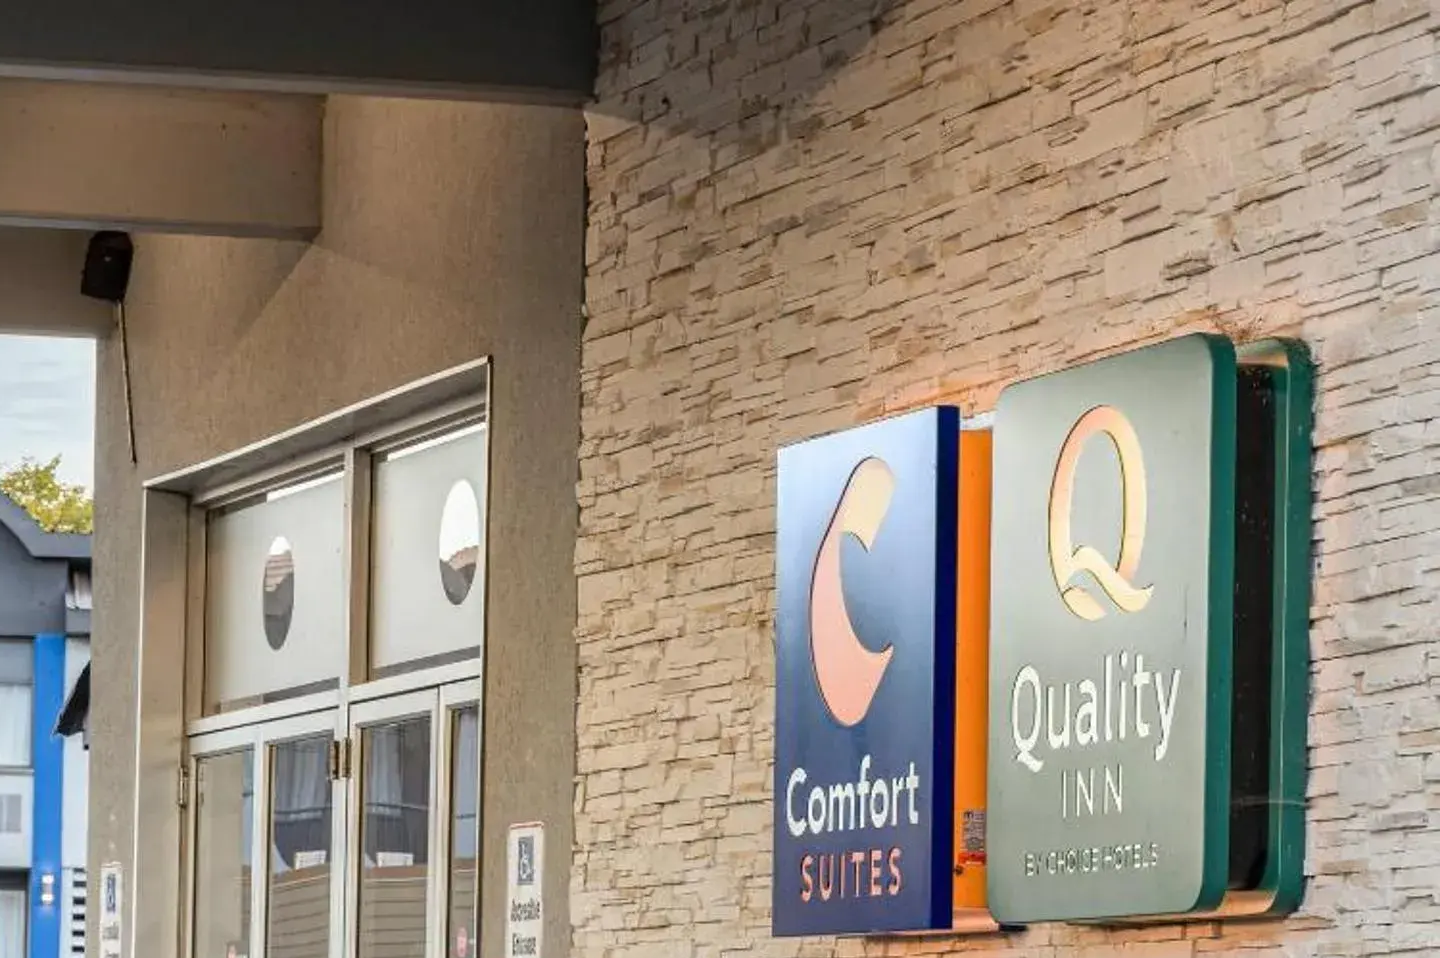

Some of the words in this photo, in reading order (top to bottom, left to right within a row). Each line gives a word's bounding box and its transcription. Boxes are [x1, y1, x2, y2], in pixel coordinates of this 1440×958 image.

[1012, 650, 1182, 773] Quality
[786, 754, 920, 837] Comfort
[1061, 764, 1123, 819] INN
[799, 847, 903, 902] SUITES
[1046, 848, 1099, 875] CHOICE
[1101, 843, 1159, 870] HOTELS
